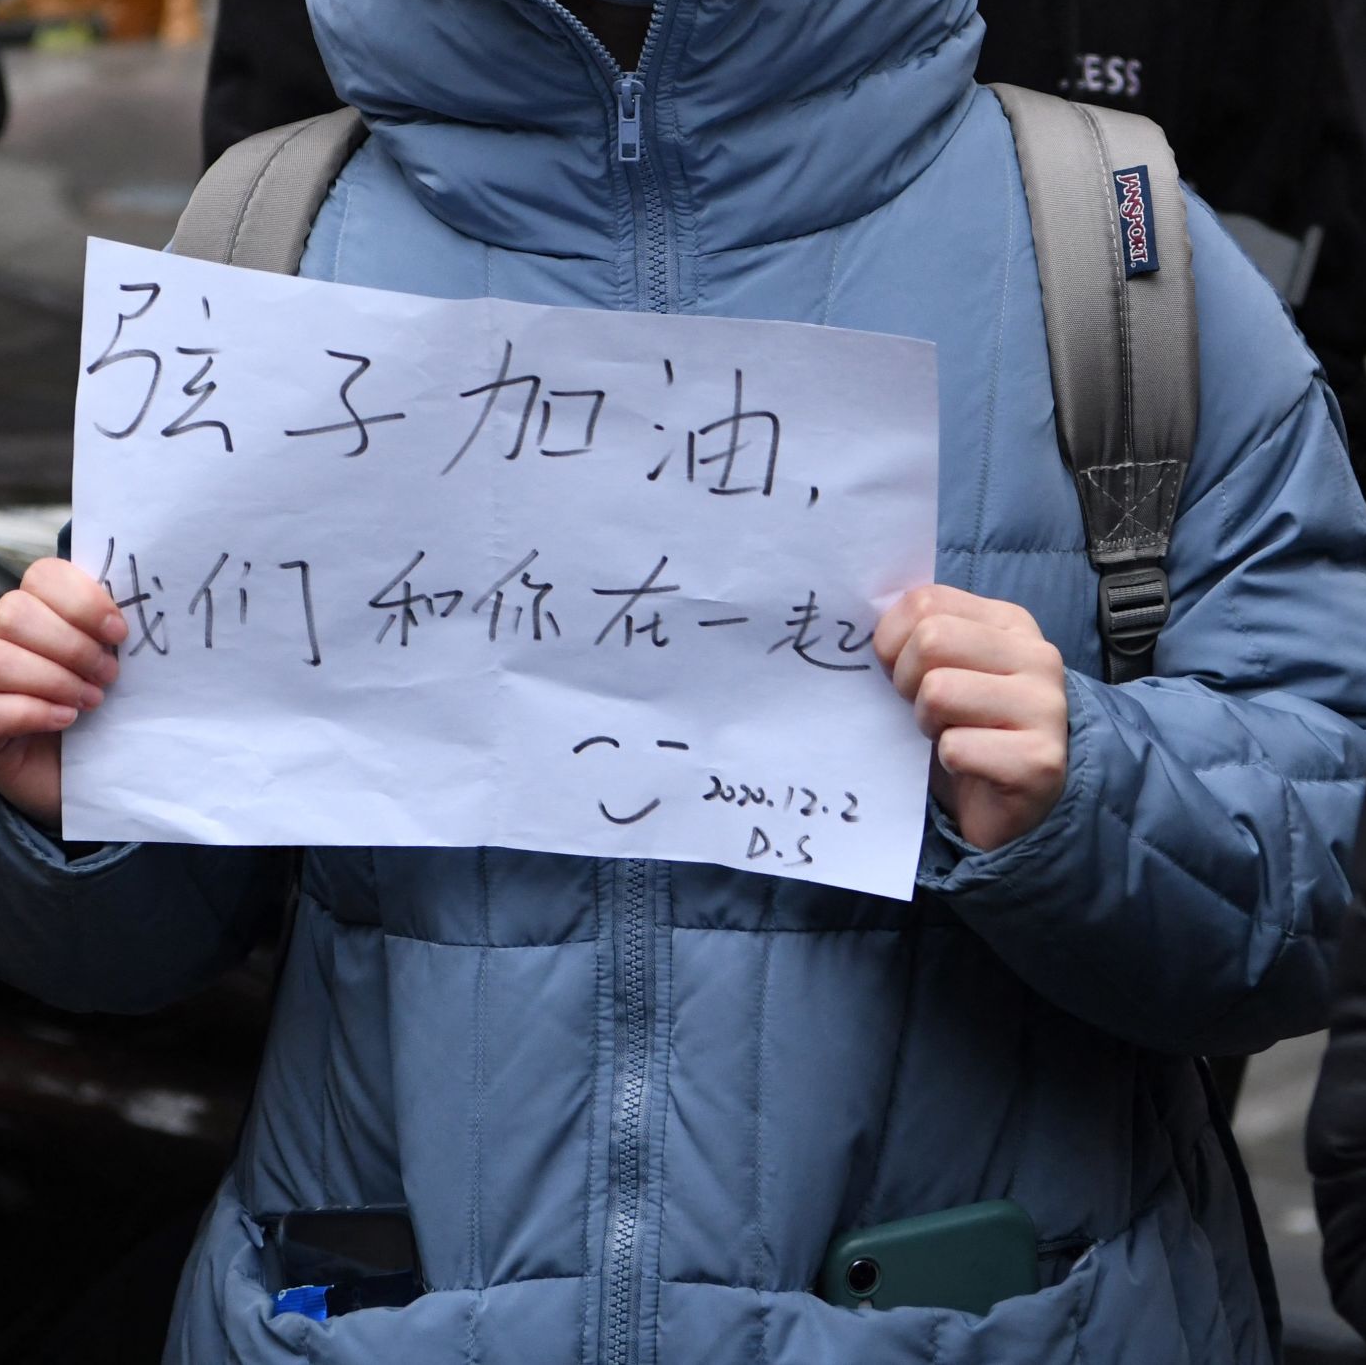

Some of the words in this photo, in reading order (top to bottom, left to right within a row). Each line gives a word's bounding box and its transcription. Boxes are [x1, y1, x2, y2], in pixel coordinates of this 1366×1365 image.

[96, 536, 875, 672] 我们和你在一起
[702, 775, 861, 823] 2020.12.2
[745, 826, 813, 867] D.S
